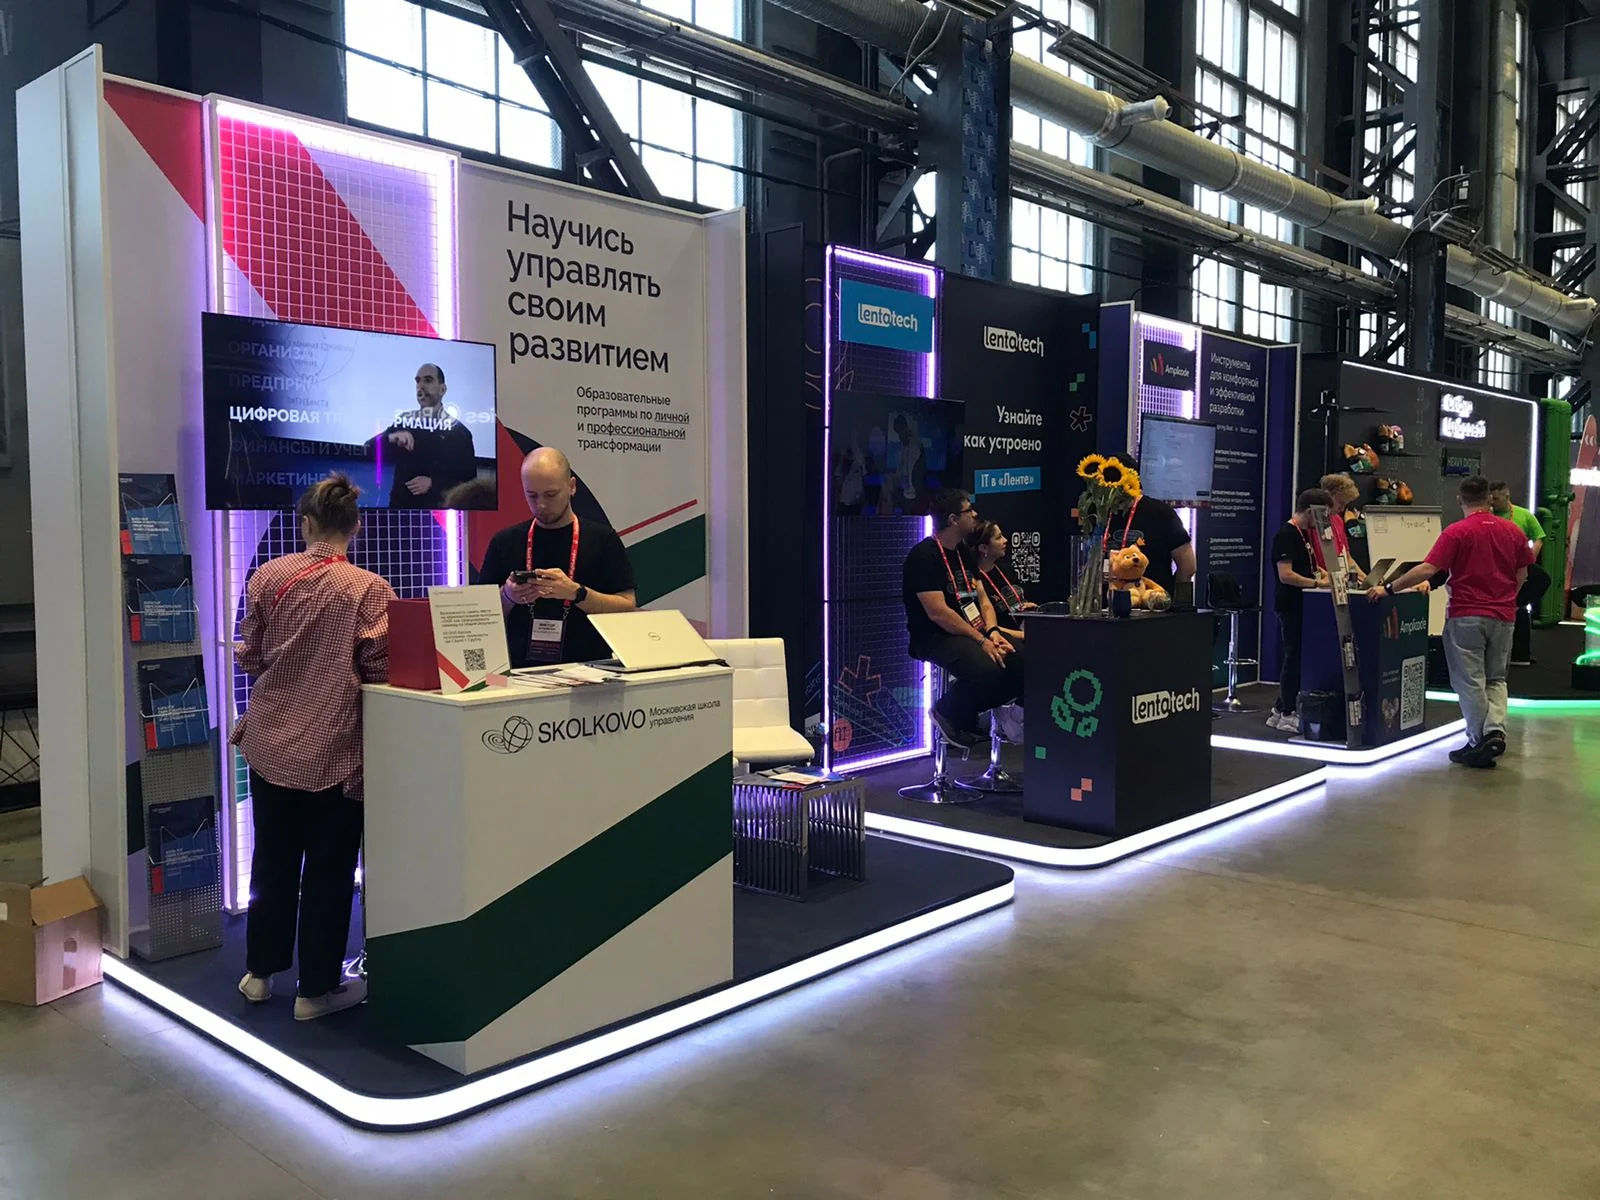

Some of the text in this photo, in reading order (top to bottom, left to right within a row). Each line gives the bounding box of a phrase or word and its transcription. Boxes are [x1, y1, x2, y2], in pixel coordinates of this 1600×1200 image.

[507, 200, 634, 255] Научись
[507, 249, 661, 298] управлять
[507, 291, 606, 327] своим
[510, 331, 669, 373] развитием
[1210, 351, 1252, 371] Инструменты
[1223, 373, 1259, 388] комфортной
[576, 386, 671, 406] Образовательные
[1215, 386, 1256, 402] эффективной
[229, 405, 320, 423] ЦИФРОВАЯ
[577, 405, 690, 424] программы по личной
[996, 405, 1043, 426] Узнайте
[1209, 403, 1245, 416] разработки
[577, 421, 686, 440] и профессиональной
[231, 438, 316, 456] ФИНАНСЫ
[319, 442, 330, 456] И
[577, 438, 661, 453] трансформации
[964, 434, 1042, 455] как устроено
[980, 473, 989, 488] IT
[991, 476, 997, 487] в
[649, 698, 721, 718] Московская школа
[538, 708, 646, 744] SKOLKOVO
[649, 712, 695, 729] управления
